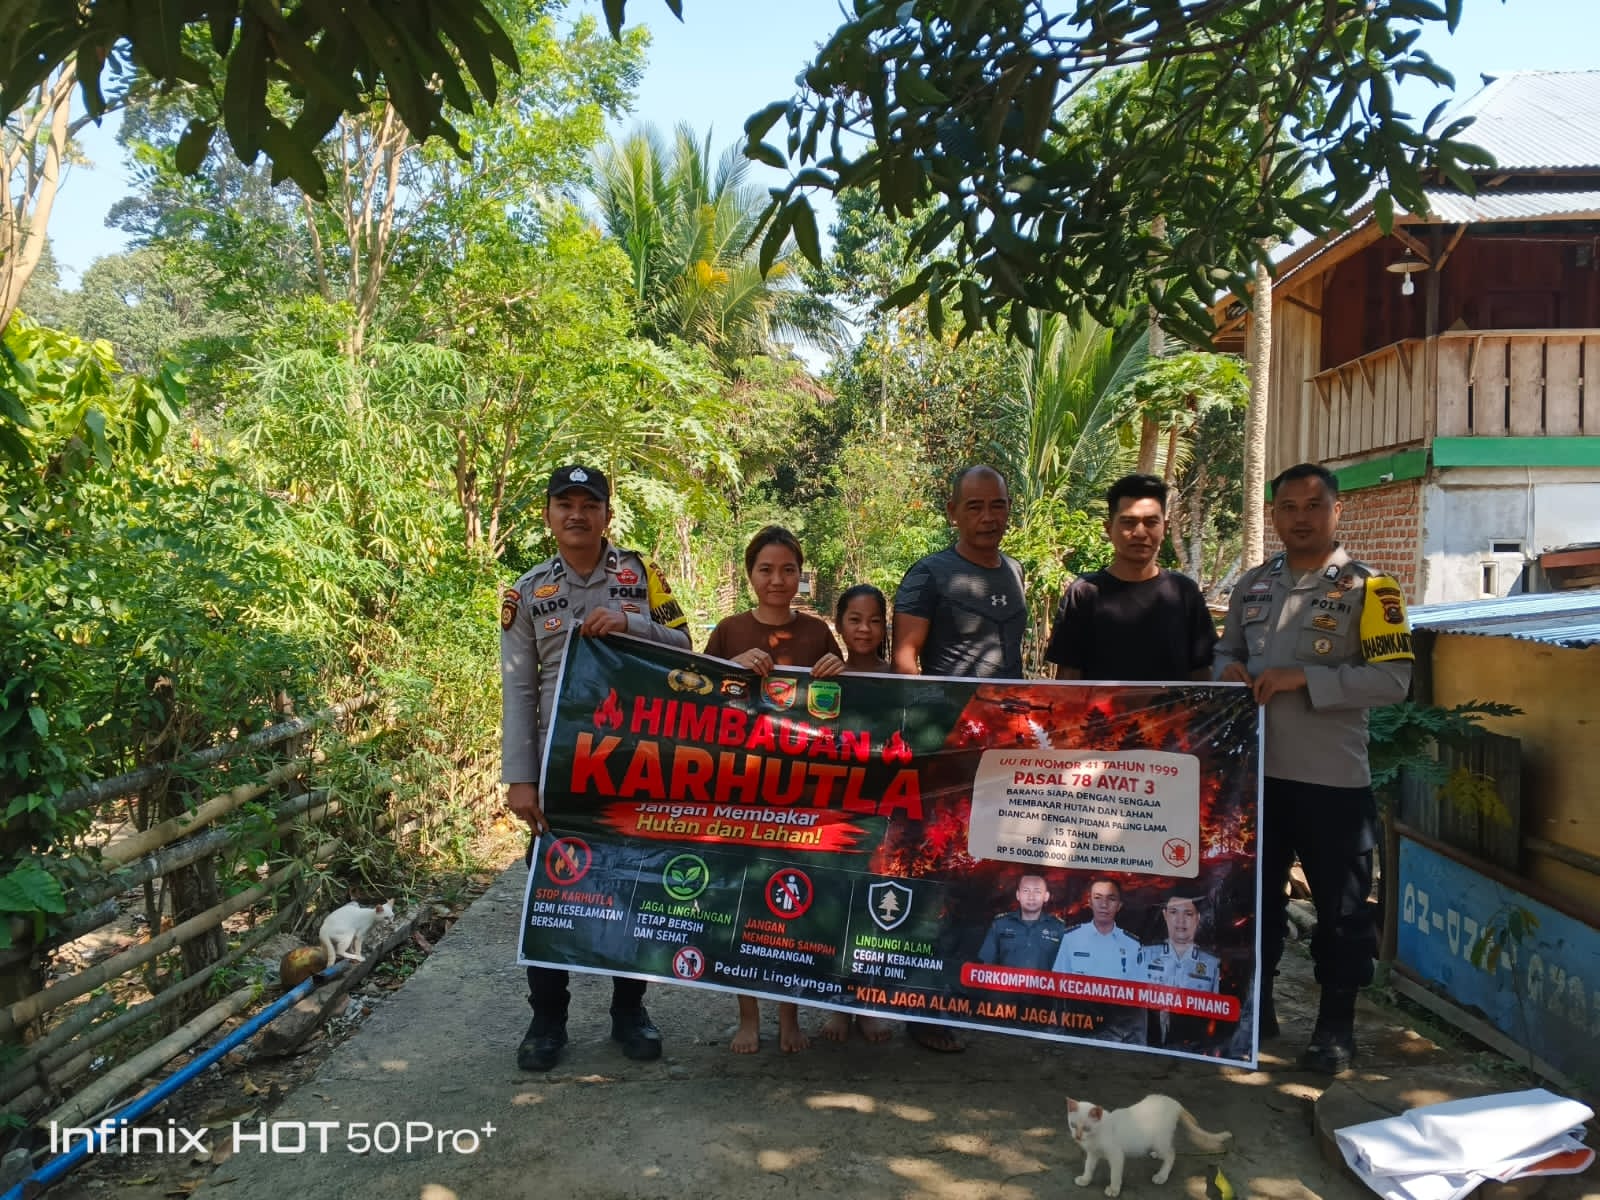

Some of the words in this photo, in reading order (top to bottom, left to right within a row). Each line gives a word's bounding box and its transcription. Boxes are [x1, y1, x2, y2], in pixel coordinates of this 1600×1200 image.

[532, 598, 569, 618] ALDO
[1311, 598, 1351, 613] POLRI
[630, 695, 871, 763] HIMBAUAN
[570, 731, 924, 821] KARHUTLA
[1035, 758, 1082, 770] NOMOR
[1085, 760, 1099, 769] 41
[1103, 760, 1145, 773] TAHUN
[1150, 763, 1179, 777] 1999
[1013, 771, 1067, 786] PASAL
[1071, 774, 1092, 788] 78
[1096, 776, 1139, 793] AYAT
[1143, 780, 1156, 795] 3
[1006, 788, 1045, 797] BARANG
[1047, 789, 1074, 800] SIAPA
[1076, 792, 1116, 804] DENGAN
[1118, 796, 1162, 808] SENGAJA
[634, 803, 708, 818] Jangan
[712, 805, 819, 826] Membakar
[1008, 798, 1062, 810] MEMBAKAR
[1064, 802, 1095, 814] HUTAN
[1097, 806, 1118, 816] DAN
[1120, 808, 1153, 819] LAHAN
[635, 815, 702, 834] Hutan
[706, 818, 747, 839] dan
[752, 822, 823, 845] Lahan!
[998, 809, 1040, 821] DIANCAM
[1041, 813, 1078, 825] DENGAN
[1079, 817, 1111, 829] PIDANA
[1112, 820, 1142, 832] PALING
[1143, 822, 1167, 833] LAMA
[1054, 827, 1065, 836] 15
[1067, 829, 1098, 839] TAHUN
[1026, 835, 1067, 848] PENJARA
[1070, 839, 1090, 850] DAN
[1092, 841, 1125, 853] DENDA
[1068, 854, 1090, 864] (LIMA
[1091, 855, 1119, 866] MILYAR
[1120, 857, 1153, 868] RUPIAH)
[535, 888, 559, 899] STOP
[561, 890, 613, 907] KARHUTLA
[533, 901, 556, 912] DEMI
[557, 904, 624, 921] KESELAMATAN
[639, 900, 664, 912] JAGA
[667, 904, 732, 925] LINGKUNGAN
[531, 915, 574, 930] BERSAMA.
[637, 913, 666, 926] TETAP
[668, 918, 704, 933] BERSIH
[744, 917, 786, 933] JANGAN
[633, 927, 654, 938] DAN
[656, 930, 689, 944] SEHAT.
[742, 931, 795, 949] MEMBUANG
[796, 940, 835, 956] SAMPAH
[855, 934, 901, 950] LINDUNGI
[739, 943, 815, 966] SEMBARANGAN.
[853, 949, 885, 963] CEGAH
[886, 953, 943, 971] KEBAKARAN
[852, 962, 881, 976] SEJAK
[884, 966, 907, 980] DINI.
[714, 961, 758, 980] Peduli
[763, 969, 842, 993] Lingkungan
[890, 991, 925, 1008] JAGA
[930, 995, 972, 1016] ALAM,
[976, 1001, 1017, 1020] ALAM
[1020, 1006, 1057, 1024] JAGA
[970, 968, 1055, 991] FORKOMPIMCA
[1059, 978, 1134, 1001] KECAMATAN
[1138, 990, 1183, 1009] MUARA
[1186, 996, 1230, 1016] PINANG
